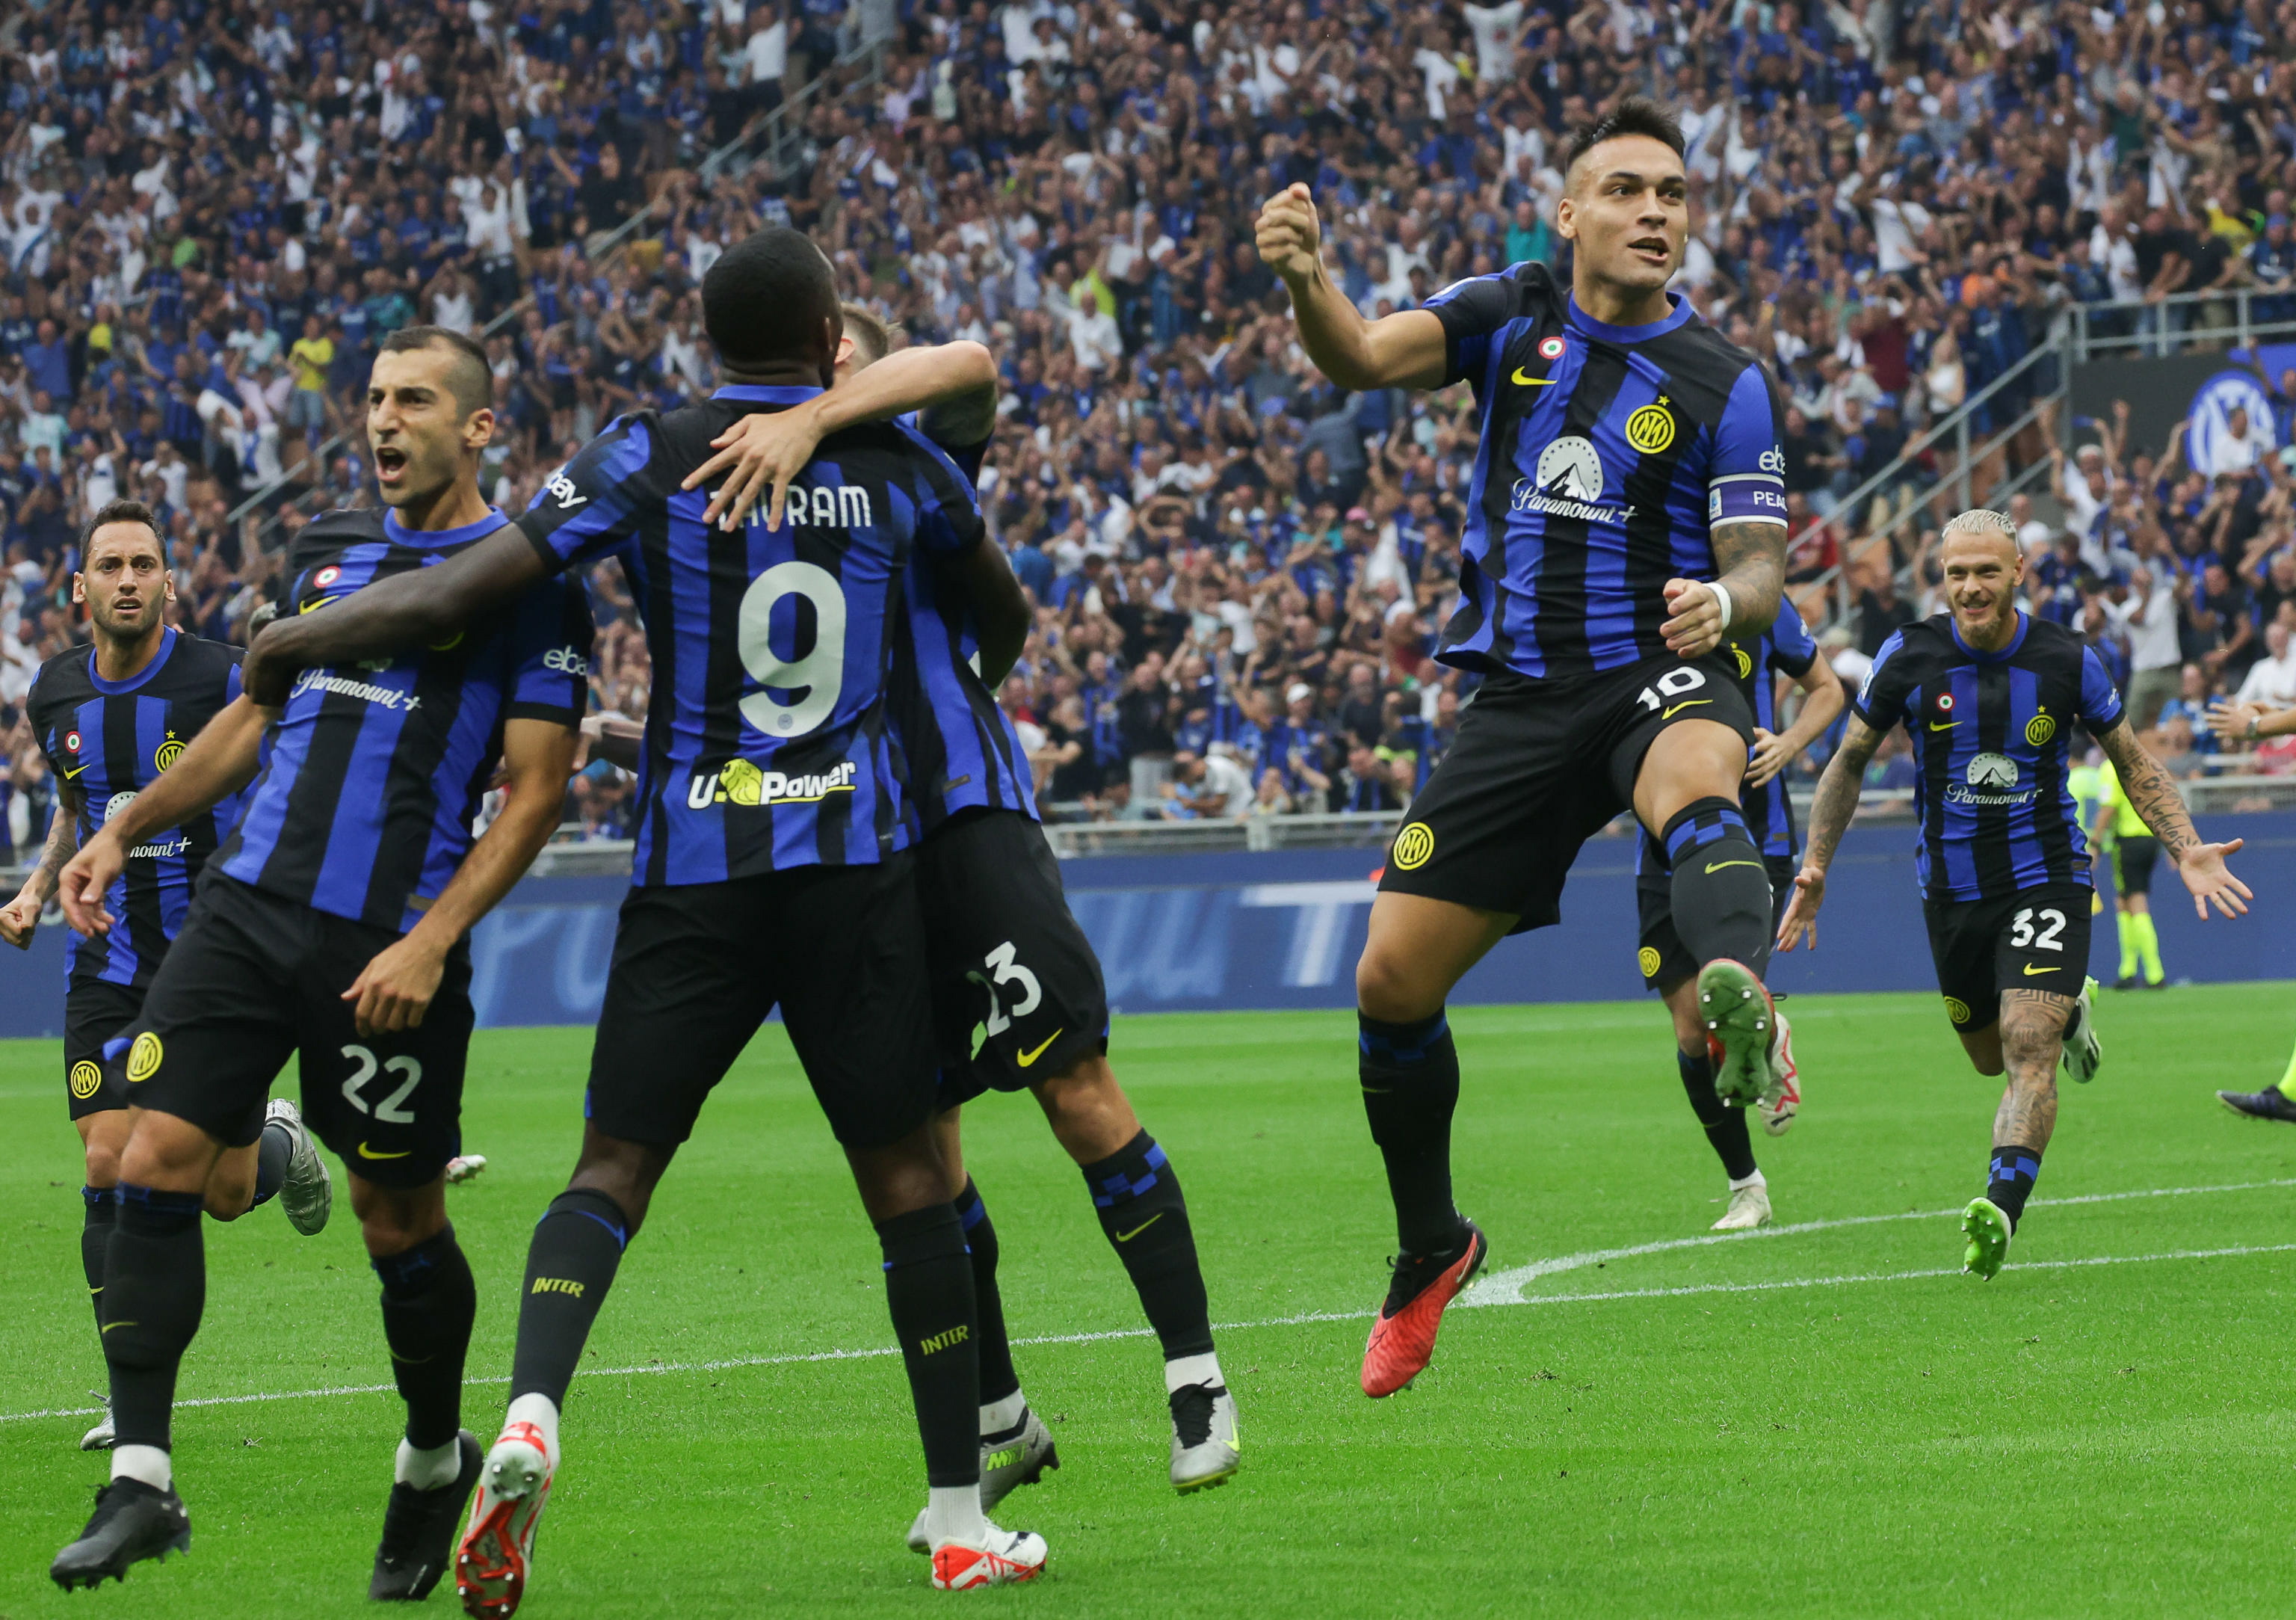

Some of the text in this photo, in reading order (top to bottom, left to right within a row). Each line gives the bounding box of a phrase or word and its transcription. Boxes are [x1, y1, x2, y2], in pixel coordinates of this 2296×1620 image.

[1759, 444, 1786, 475] eb
[546, 464, 587, 508] bay
[1511, 477, 1638, 523] Paramount+
[1753, 490, 1788, 512] PEA
[543, 644, 587, 676] eba
[738, 561, 846, 738] 9
[290, 668, 422, 711] Paramount+
[1636, 666, 1706, 711] 10
[2010, 908, 2067, 951] 32
[341, 1045, 422, 1123] 22
[531, 1277, 584, 1298] INTER
[921, 1325, 969, 1355] INTER
